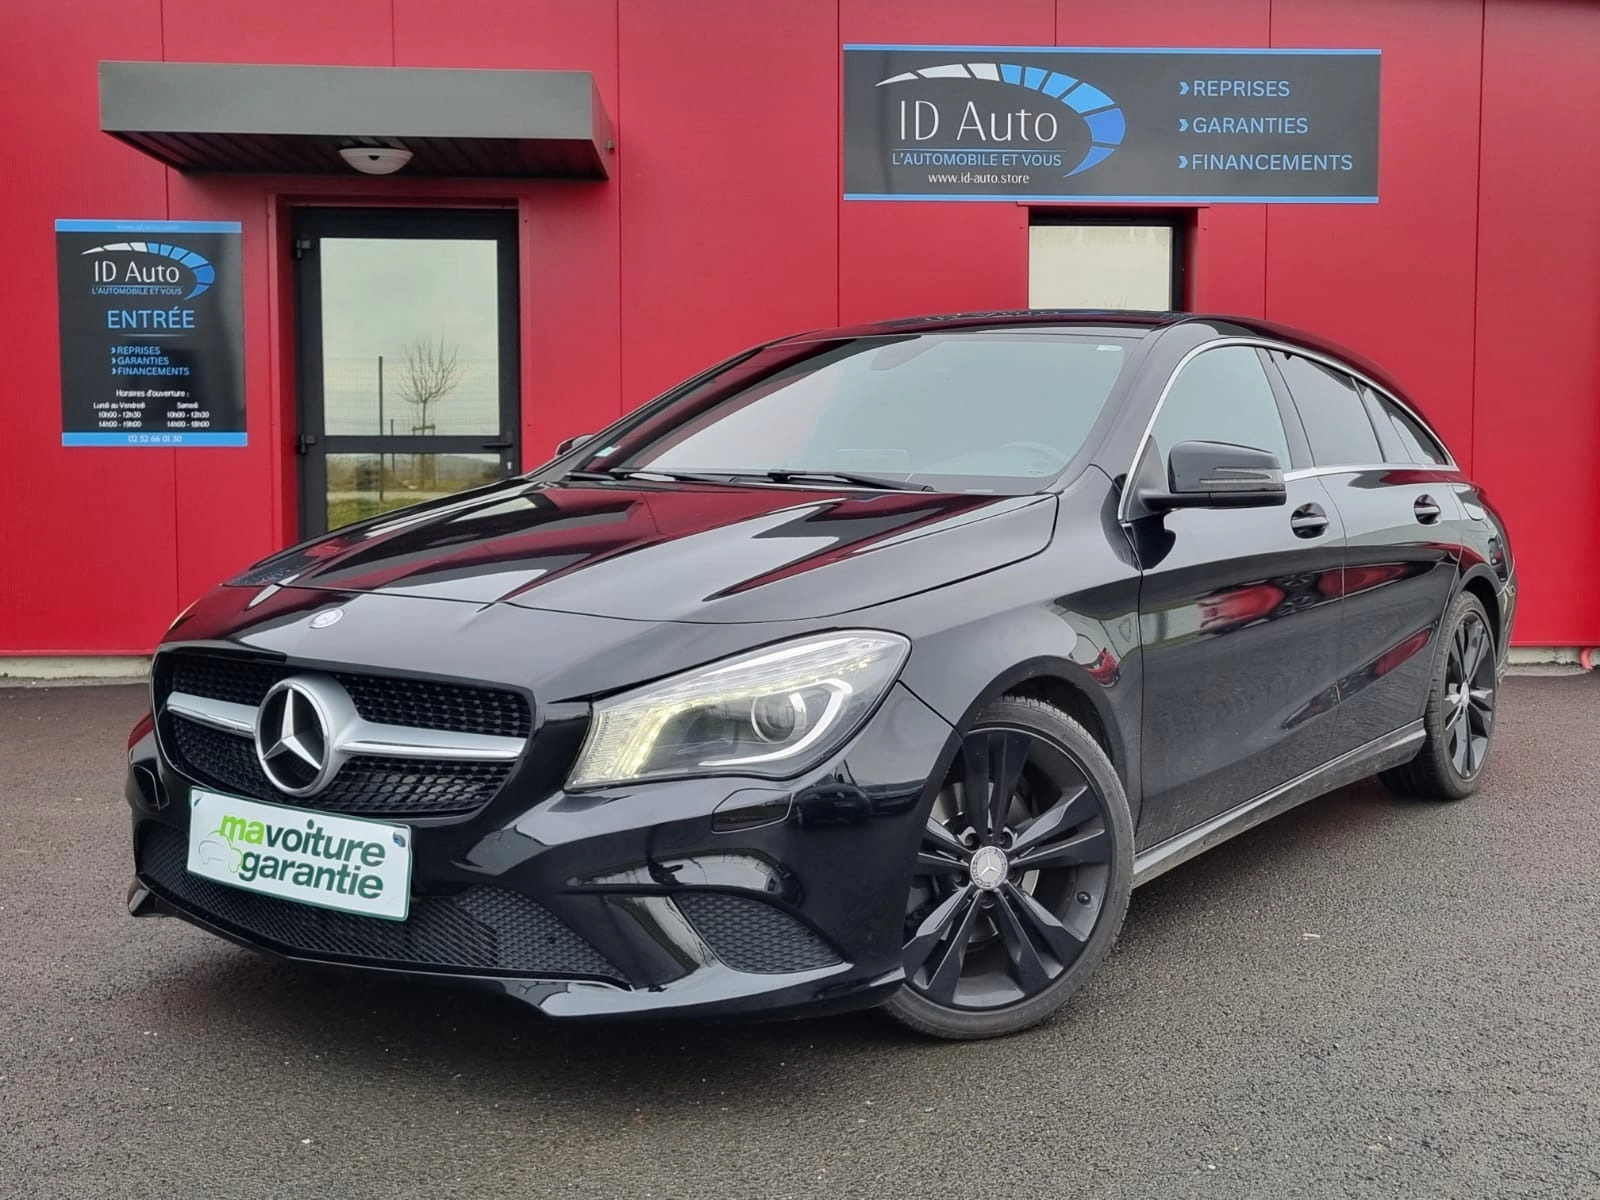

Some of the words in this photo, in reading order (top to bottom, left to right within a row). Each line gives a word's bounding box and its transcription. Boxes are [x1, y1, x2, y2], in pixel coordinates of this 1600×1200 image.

[1193, 80, 1290, 97] REPRISES
[900, 100, 939, 141] ID
[956, 100, 1058, 142] Auto
[1192, 116, 1309, 134] GARANTIES
[892, 152, 998, 166] L’AUTOMOBILE
[1001, 154, 1018, 166] ET
[1022, 154, 1062, 167] VOUS
[1192, 153, 1353, 171] FINANCEMENTS
[928, 172, 1030, 184] www.id-auto.store
[94, 260, 117, 283] ID
[124, 260, 180, 283] Auto
[150, 287, 159, 296] ET
[160, 287, 183, 296] VOUS
[107, 306, 195, 329] ENTRÉE
[116, 346, 161, 355] REPRISES
[117, 356, 170, 366] GARANTIES
[117, 366, 190, 376] FINANCEMENTS
[116, 389, 145, 398] Horaires
[93, 401, 110, 409] Lundi
[119, 401, 146, 409] Vendredi
[176, 401, 199, 409] Samedi
[128, 435, 138, 443] 02
[220, 814, 386, 868] mavoiture
[238, 850, 384, 899] garantie
